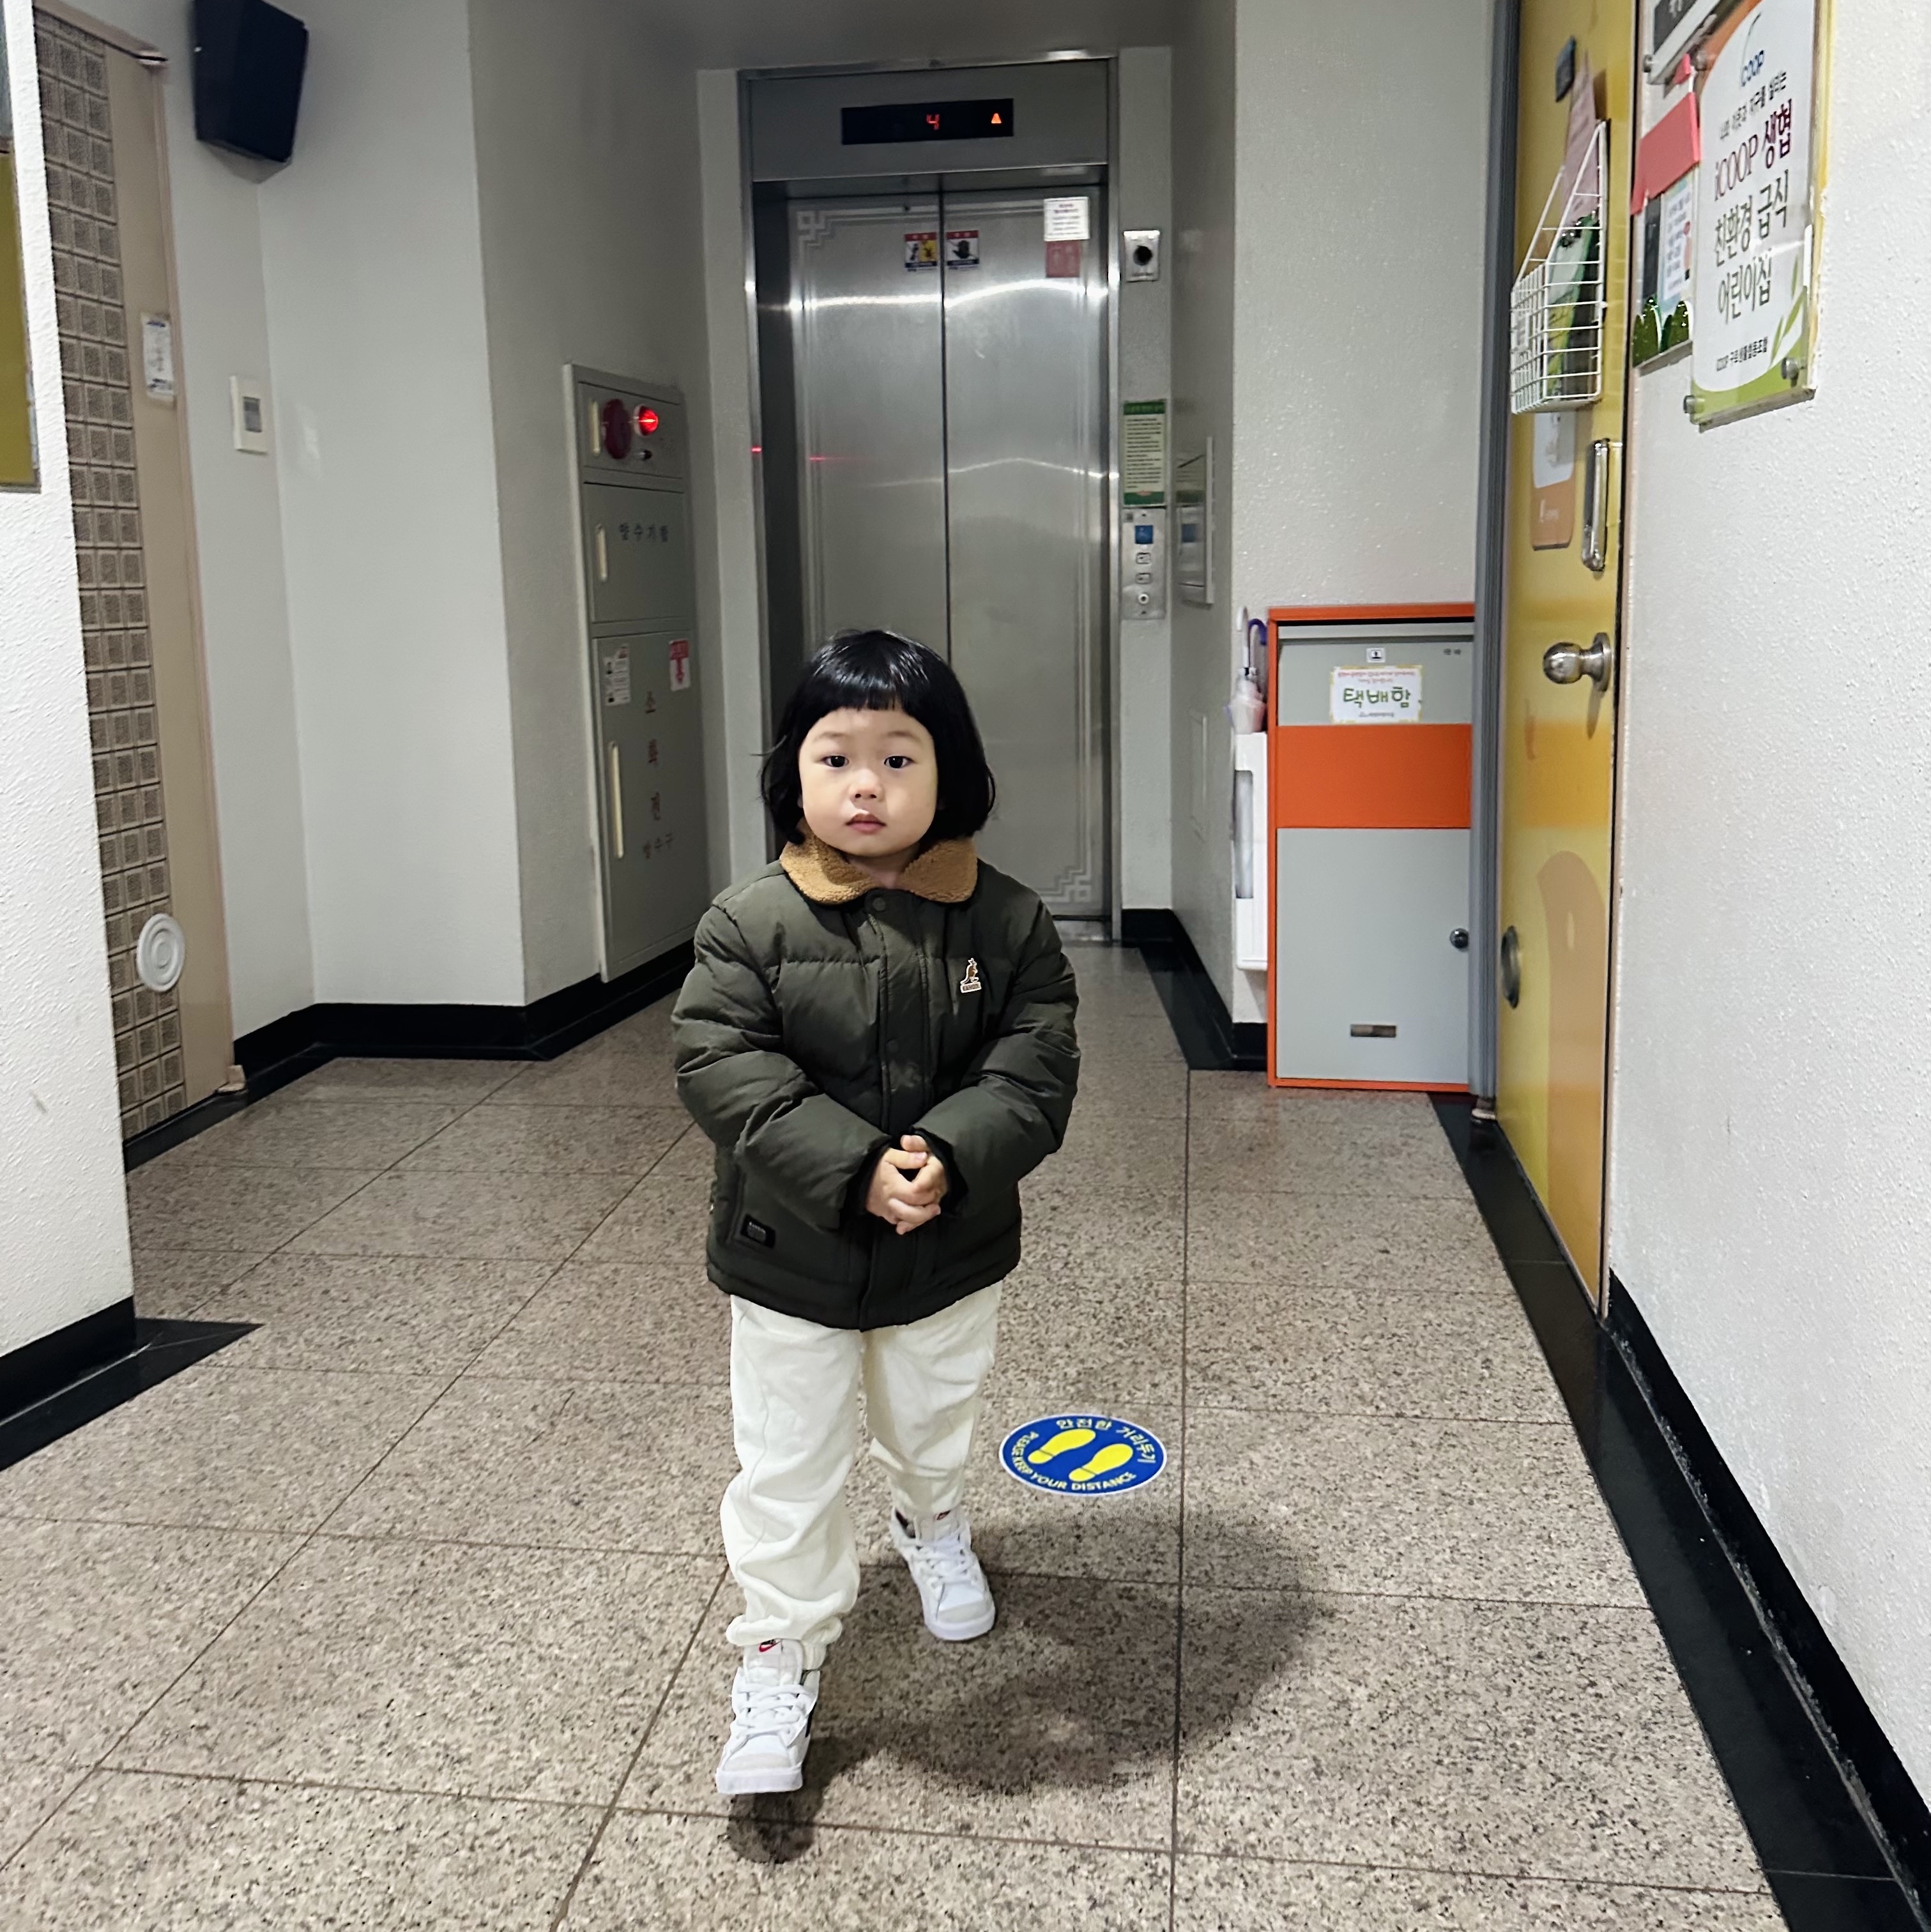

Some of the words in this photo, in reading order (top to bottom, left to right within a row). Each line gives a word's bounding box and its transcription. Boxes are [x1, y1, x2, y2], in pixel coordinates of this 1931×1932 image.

[926, 114, 940, 131] 4
[1715, 134, 1758, 201] iCOOP
[1762, 98, 1792, 169] 생협
[1715, 194, 1753, 268] 친환경
[1757, 169, 1789, 240] 급식
[1718, 248, 1773, 325] 어린이집
[1343, 686, 1411, 708] 택배함
[1056, 1418, 1112, 1431] 안전한
[1115, 1426, 1156, 1464] 거리두기
[1030, 1472, 1067, 1489] YOUR
[1071, 1472, 1137, 1491] DISTANCE
